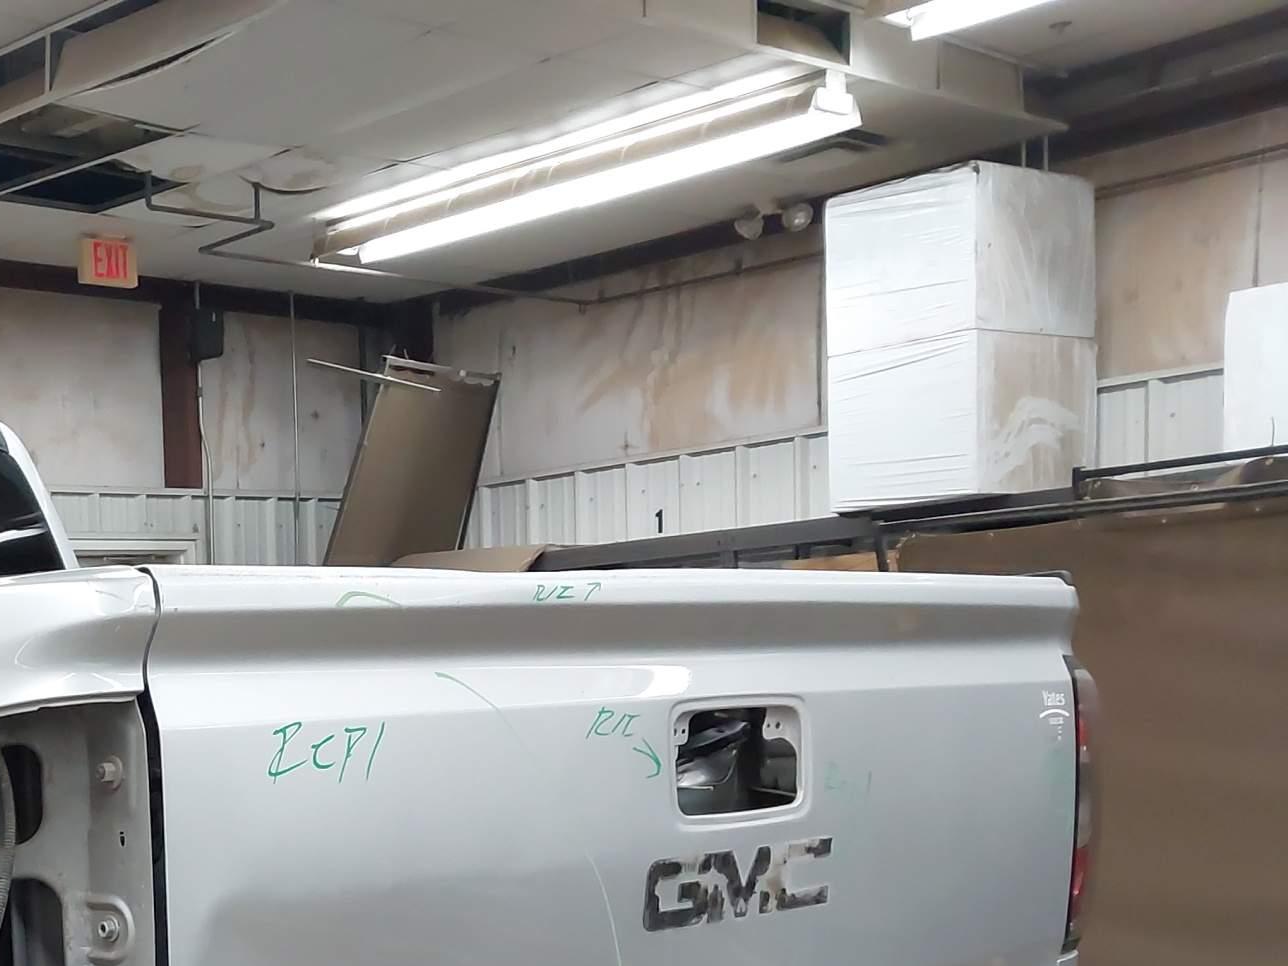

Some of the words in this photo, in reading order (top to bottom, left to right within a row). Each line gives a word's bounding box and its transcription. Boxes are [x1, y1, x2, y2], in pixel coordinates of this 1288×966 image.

[92, 240, 129, 280] EXIT
[655, 508, 663, 534] 1
[642, 836, 833, 933] GMC
